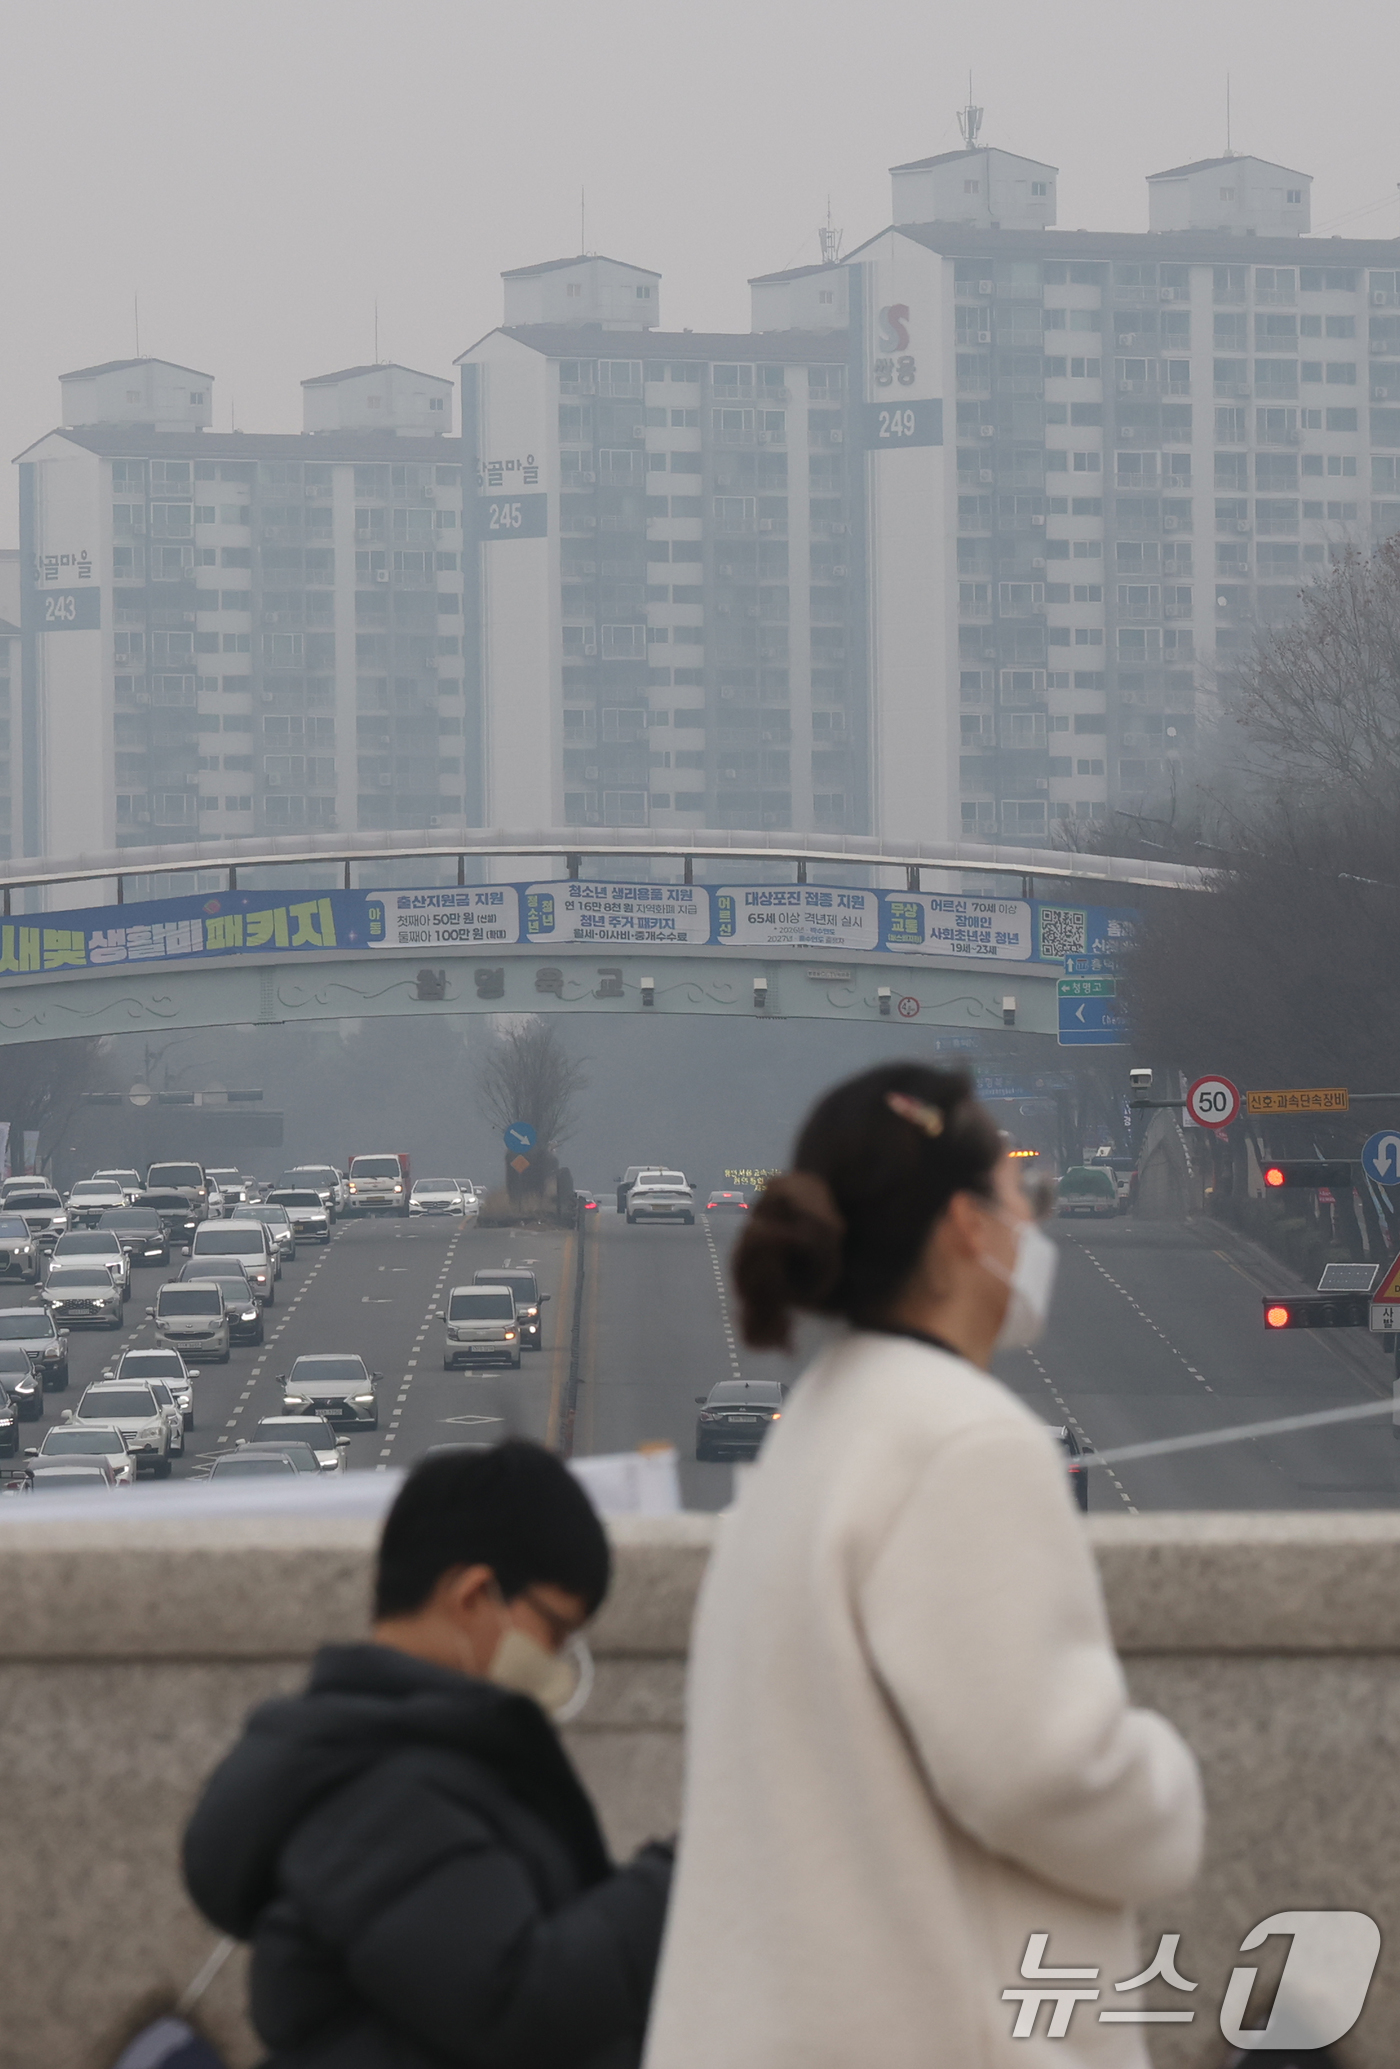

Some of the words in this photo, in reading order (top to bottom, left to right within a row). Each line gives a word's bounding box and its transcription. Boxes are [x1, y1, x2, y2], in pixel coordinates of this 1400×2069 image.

[878, 409, 915, 438] 249
[489, 503, 522, 529] 245
[46, 595, 76, 621] 243
[397, 893, 470, 910] 출산지원금
[475, 891, 504, 906] 지원
[569, 884, 607, 899] 청소년
[611, 887, 663, 901] 생리용품
[667, 889, 693, 902] 지원
[745, 891, 800, 907] 대상포진
[805, 891, 833, 908] 접종
[837, 894, 865, 910] 지원
[564, 901, 574, 911] 연
[578, 901, 601, 912] 16만
[603, 902, 623, 912] 8천
[623, 903, 633, 913] 원
[636, 904, 675, 914] 지역화폐
[677, 905, 697, 915] 지급
[891, 902, 918, 918] 무상
[931, 899, 967, 914] 어르신
[971, 902, 996, 914] 70세
[998, 904, 1017, 915] 이상
[369, 908, 381, 935] 아동
[397, 914, 430, 928] 첫째아
[432, 913, 460, 925] 50만
[463, 912, 474, 924] 원
[580, 914, 605, 928] 청년
[608, 916, 634, 929] 주거
[638, 917, 675, 930] 패키지
[718, 897, 732, 936] 어르신
[748, 913, 776, 924] 65세
[778, 912, 800, 924] 이상
[804, 912, 838, 927] 격년제
[841, 915, 863, 928] 실시
[955, 915, 992, 929] 장애인
[88, 919, 203, 964] 생활비
[206, 898, 337, 950] 패키지
[891, 919, 918, 933] 교통
[398, 930, 431, 943] 둘째아
[435, 928, 470, 941] 100만
[473, 928, 484, 940] 원
[930, 927, 991, 943] 사회초년생
[994, 931, 1019, 945] 청년
[1199, 1091, 1227, 1112] 50
[1251, 1092, 1345, 1109] 신호·과속단속장비
